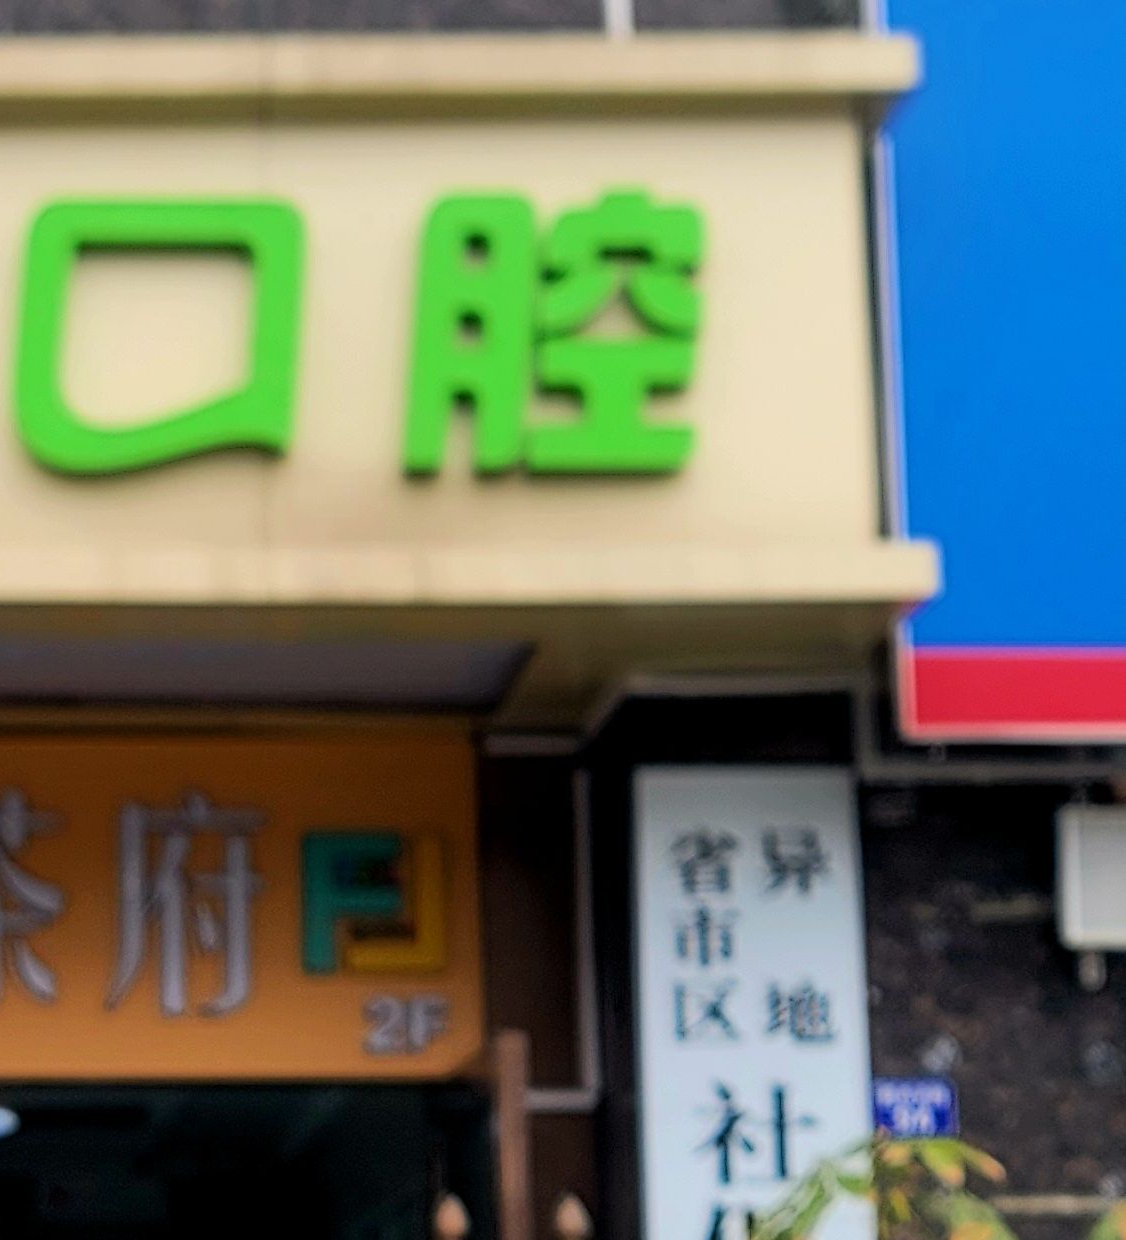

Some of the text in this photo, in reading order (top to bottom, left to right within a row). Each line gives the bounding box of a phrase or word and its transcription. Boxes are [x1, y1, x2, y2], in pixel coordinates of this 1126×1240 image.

[362, 994, 451, 1055] 2F
[673, 827, 740, 1040] 省市区
[761, 826, 834, 1042] 异地
